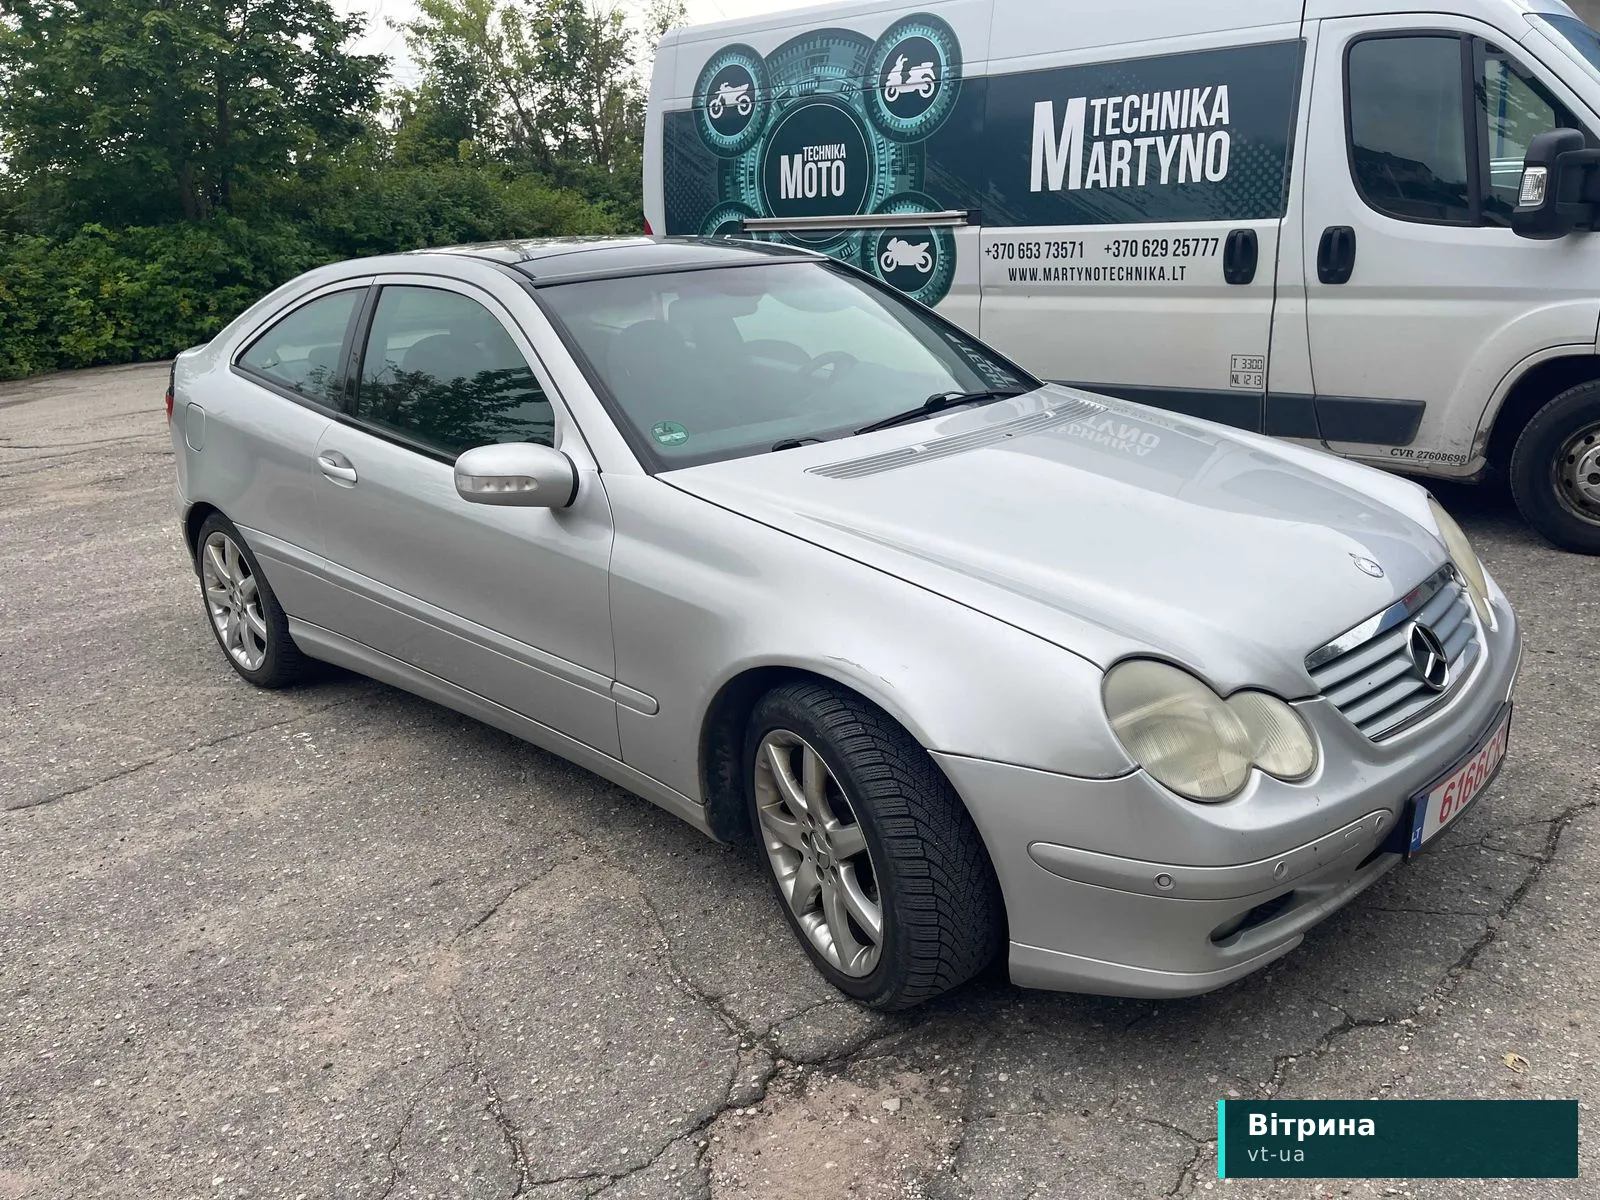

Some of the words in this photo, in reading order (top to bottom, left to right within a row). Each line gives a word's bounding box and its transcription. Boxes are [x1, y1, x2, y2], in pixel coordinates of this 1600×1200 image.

[1090, 84, 1230, 137] TECHNIKA
[802, 144, 847, 161] TECHNIKA
[1030, 96, 1231, 192] MARTYNO
[780, 153, 845, 199] MOTO
[984, 243, 1014, 260] +370
[1018, 242, 1041, 259] 653
[1044, 241, 1084, 259] 73571
[1104, 239, 1138, 258] +370
[1142, 238, 1168, 257] 629
[1172, 237, 1219, 257] 25777
[1008, 265, 1187, 282] WWW.MARTYNOTECHNIKA.LT
[1232, 358, 1238, 369] T
[1241, 358, 1263, 370] 3300
[1231, 374, 1240, 385] NL
[1390, 448, 1414, 458] CVR
[1416, 450, 1467, 463] 27608698
[1411, 826, 1422, 842] LT
